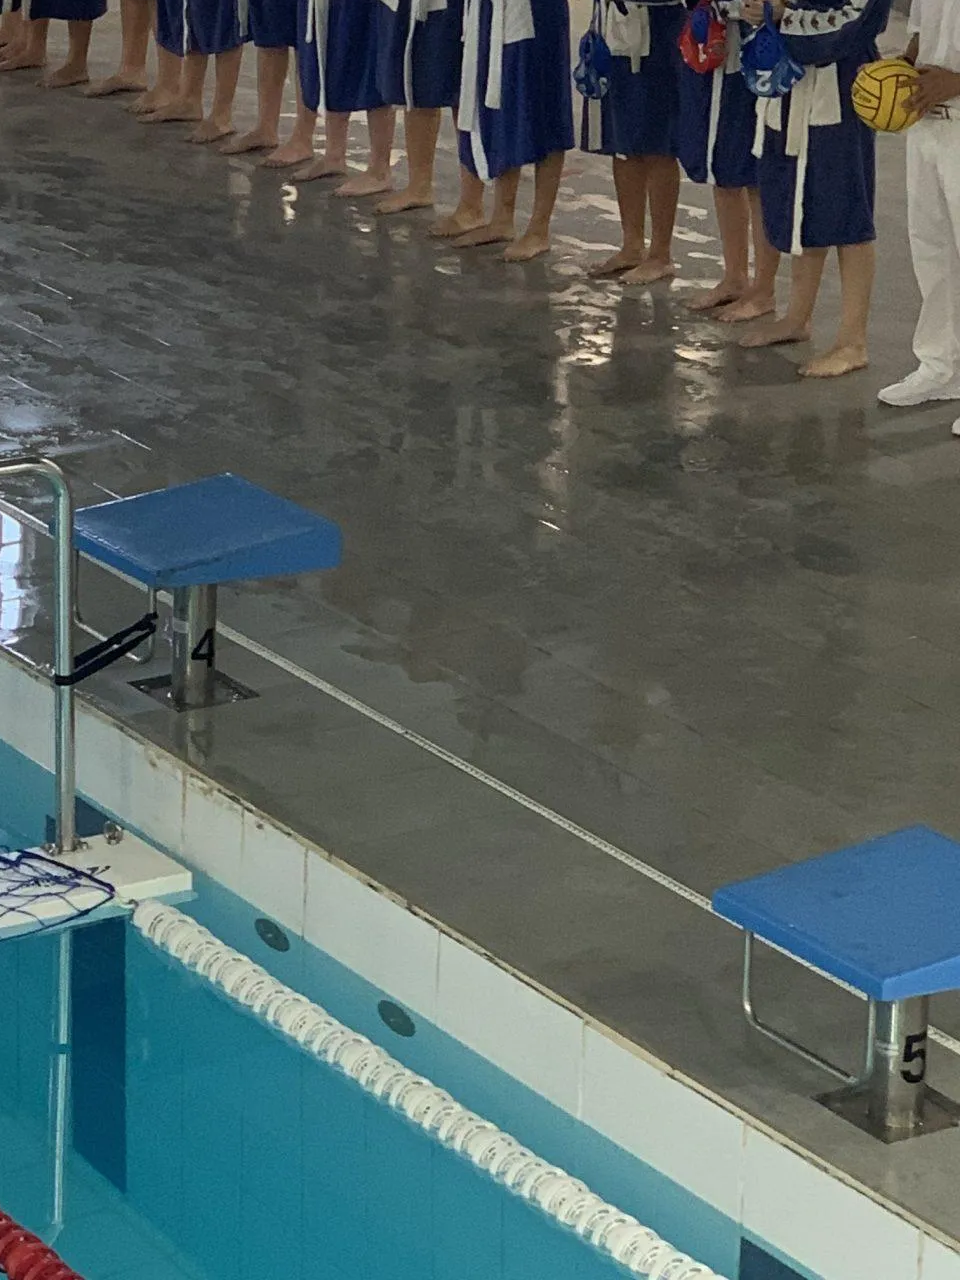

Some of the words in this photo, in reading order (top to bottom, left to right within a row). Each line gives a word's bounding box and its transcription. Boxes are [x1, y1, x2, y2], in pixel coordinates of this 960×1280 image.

[755, 69, 772, 92] 2
[191, 628, 215, 668] 4
[900, 1030, 928, 1083] 5
